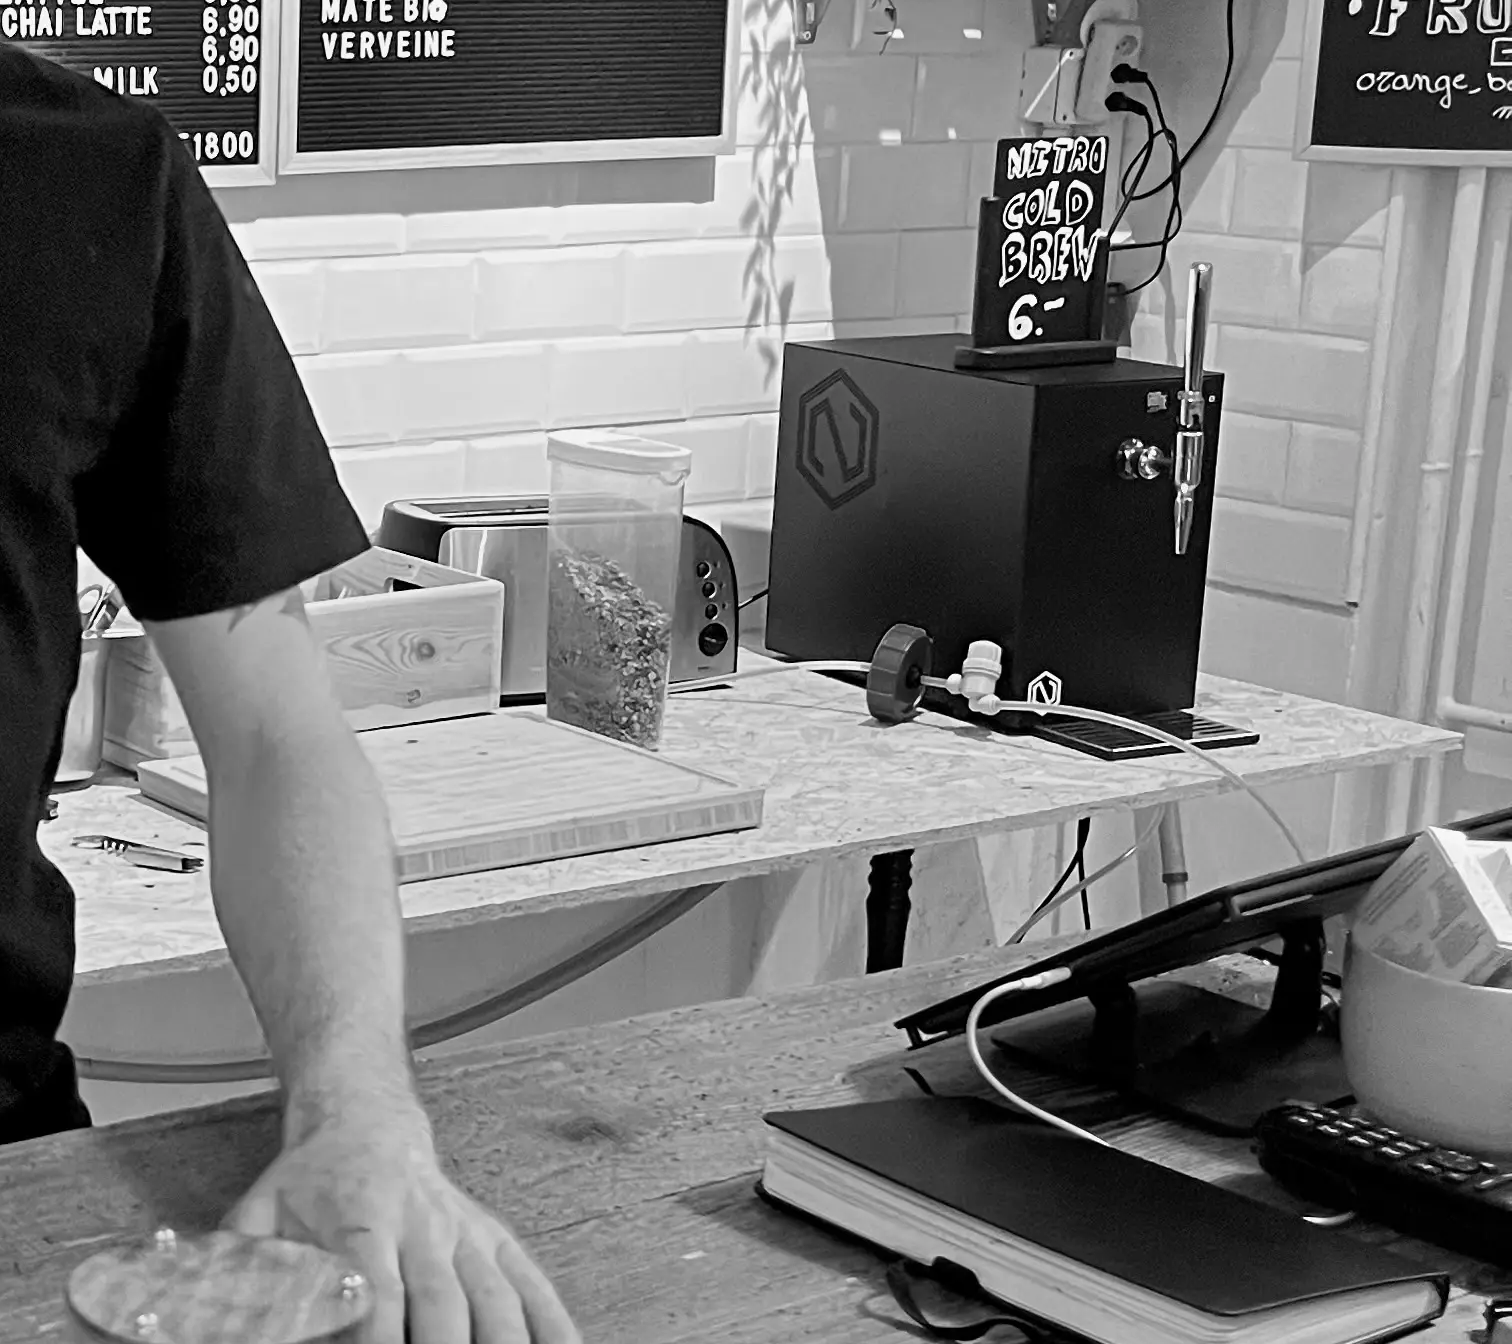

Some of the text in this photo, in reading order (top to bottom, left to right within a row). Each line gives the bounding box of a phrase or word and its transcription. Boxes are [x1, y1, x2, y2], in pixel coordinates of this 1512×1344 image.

[77, 6, 152, 35] LATTE
[322, 30, 455, 59] VERVEINE
[93, 66, 159, 95] MILK
[1007, 136, 1106, 180] NITRO
[1002, 179, 1094, 230] COLD
[998, 224, 1102, 288] BREW
